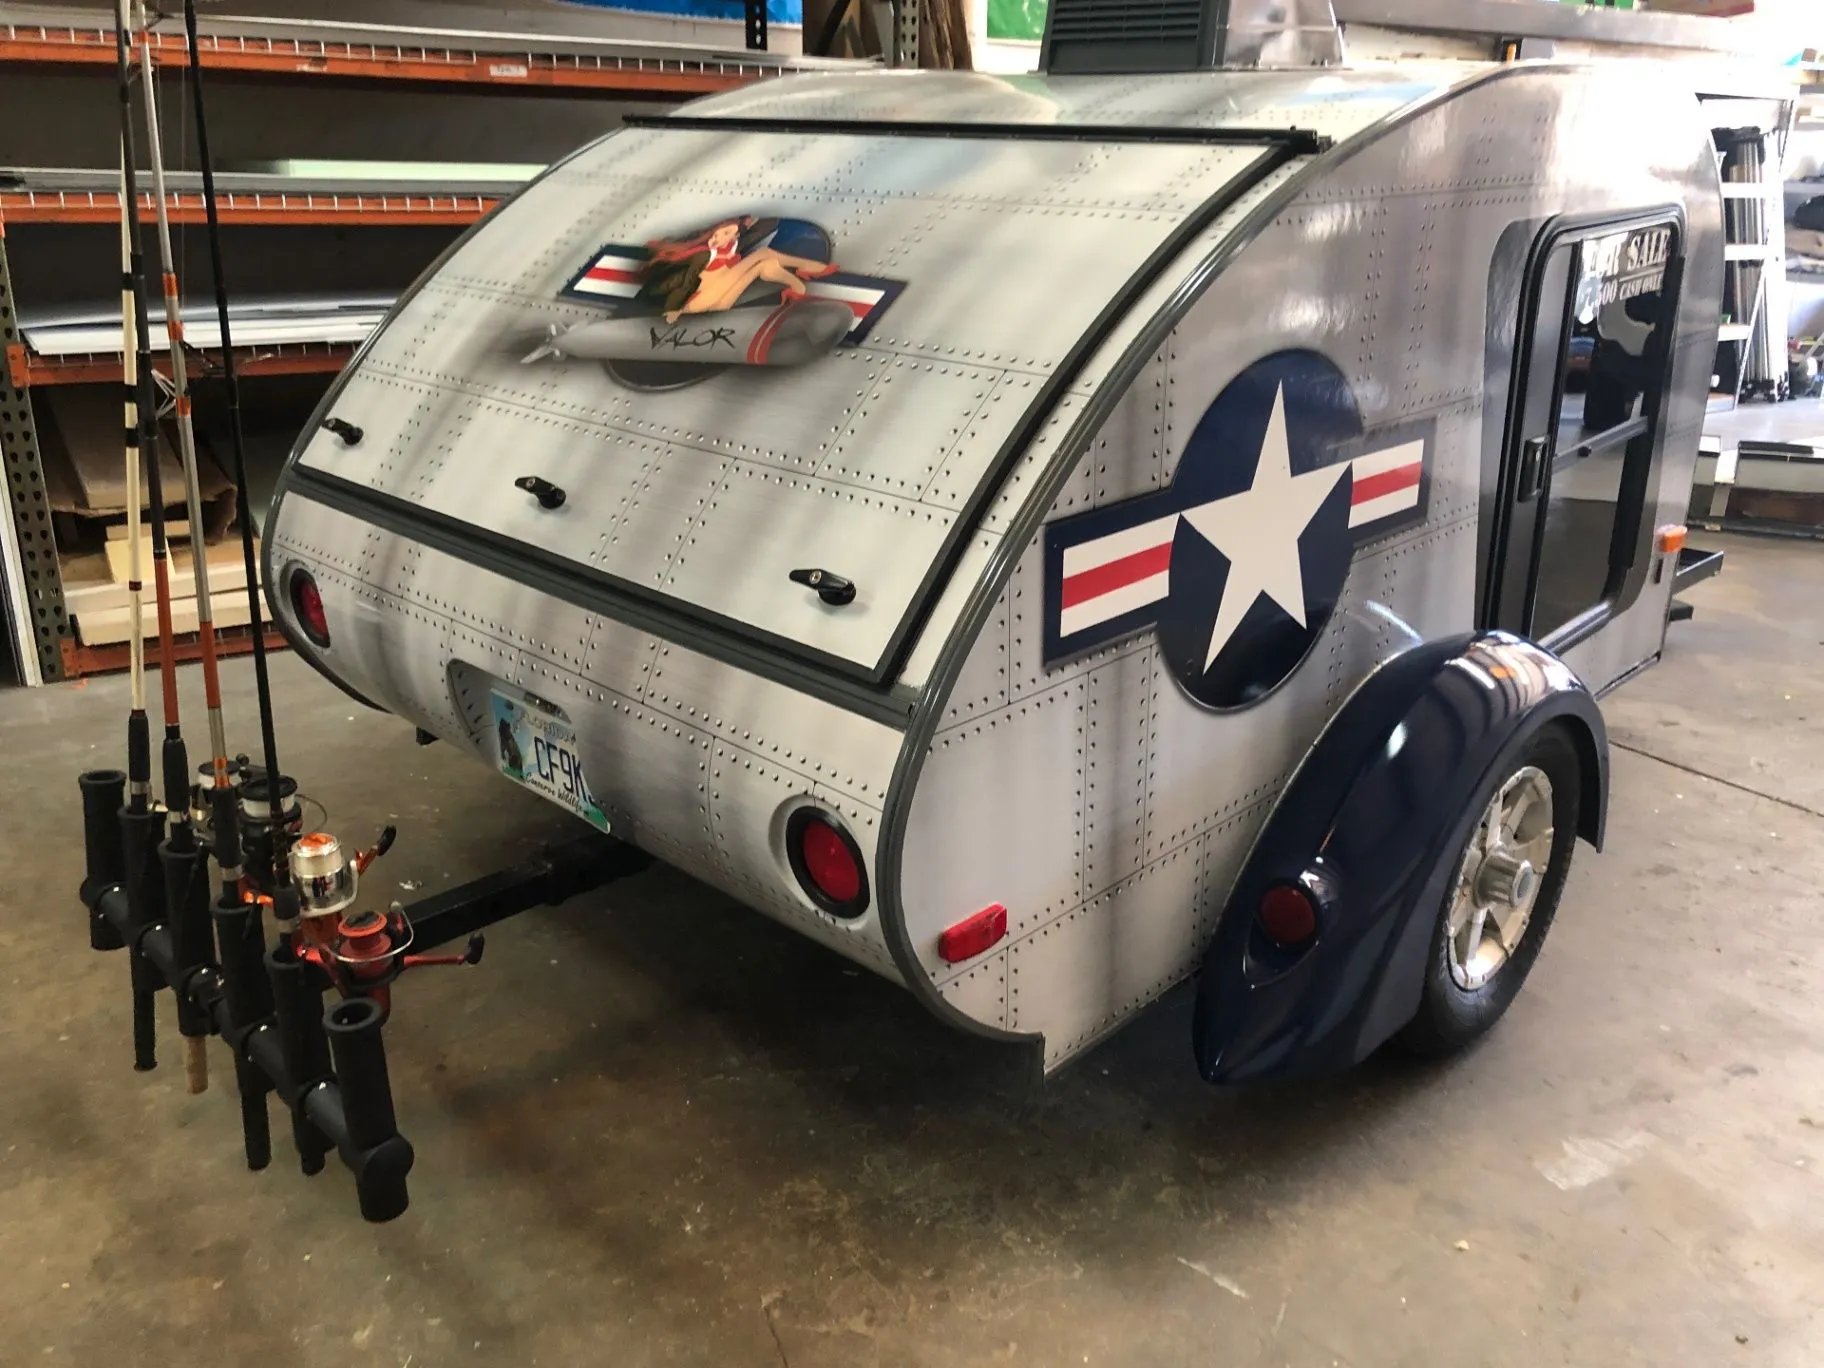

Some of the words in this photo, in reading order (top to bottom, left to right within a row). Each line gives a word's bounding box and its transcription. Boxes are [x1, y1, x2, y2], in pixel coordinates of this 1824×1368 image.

[1627, 229, 1671, 271] SALE
[650, 325, 735, 350] VALOR
[534, 736, 596, 806] CF9K
